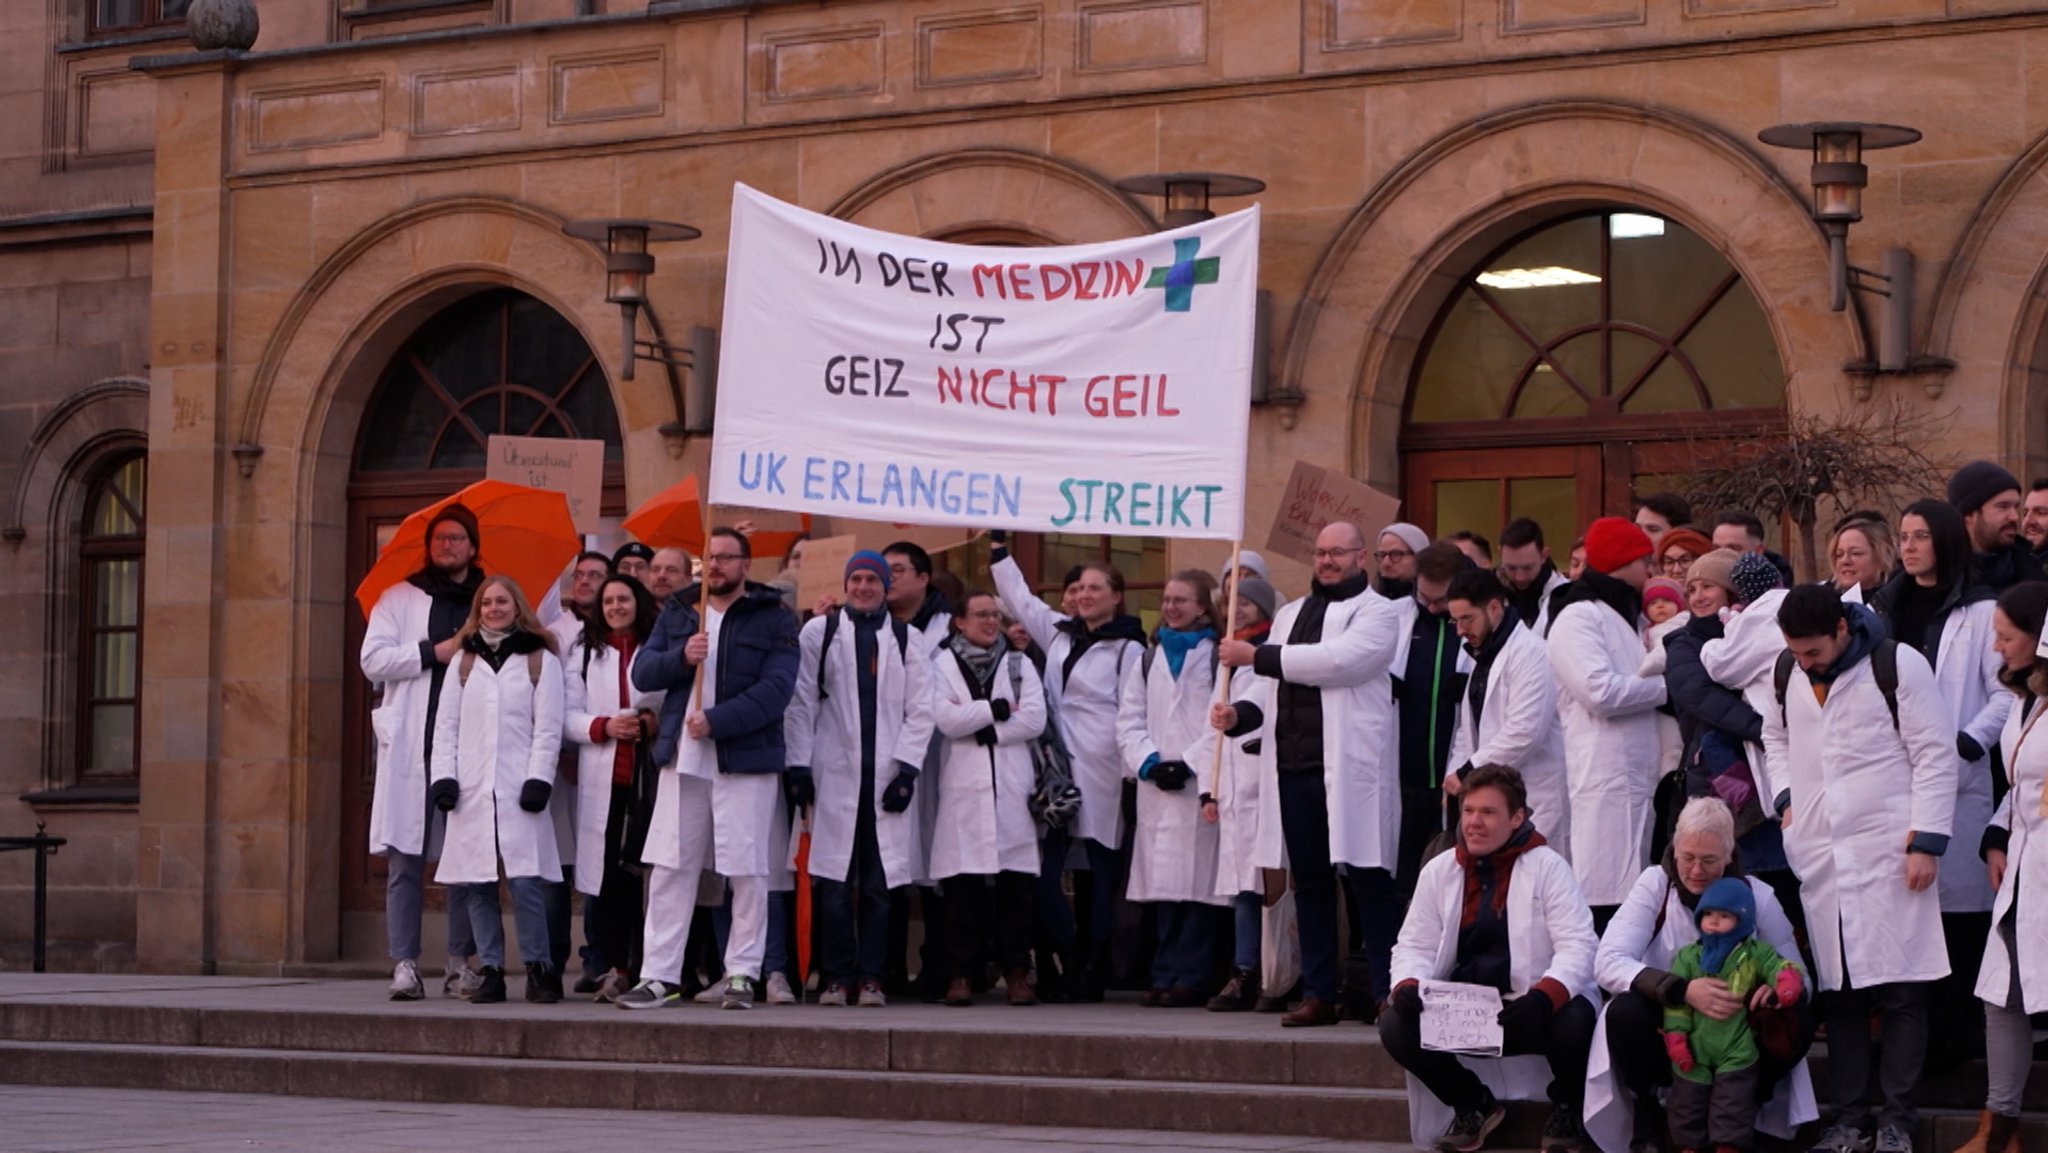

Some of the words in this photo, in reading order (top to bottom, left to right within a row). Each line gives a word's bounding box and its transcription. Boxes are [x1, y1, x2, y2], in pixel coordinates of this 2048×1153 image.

[818, 239, 862, 284] IN
[878, 252, 955, 297] DER
[971, 258, 1145, 301] MEDIZIN
[929, 314, 1005, 352] IST
[824, 355, 909, 398] GEIZ
[937, 366, 1067, 417] NICHT
[1084, 374, 1180, 418] GEIL
[528, 469, 547, 488] ist
[738, 452, 787, 496] UK
[802, 457, 1022, 519] ERLANGEN
[1050, 478, 1222, 528] STREIKT
